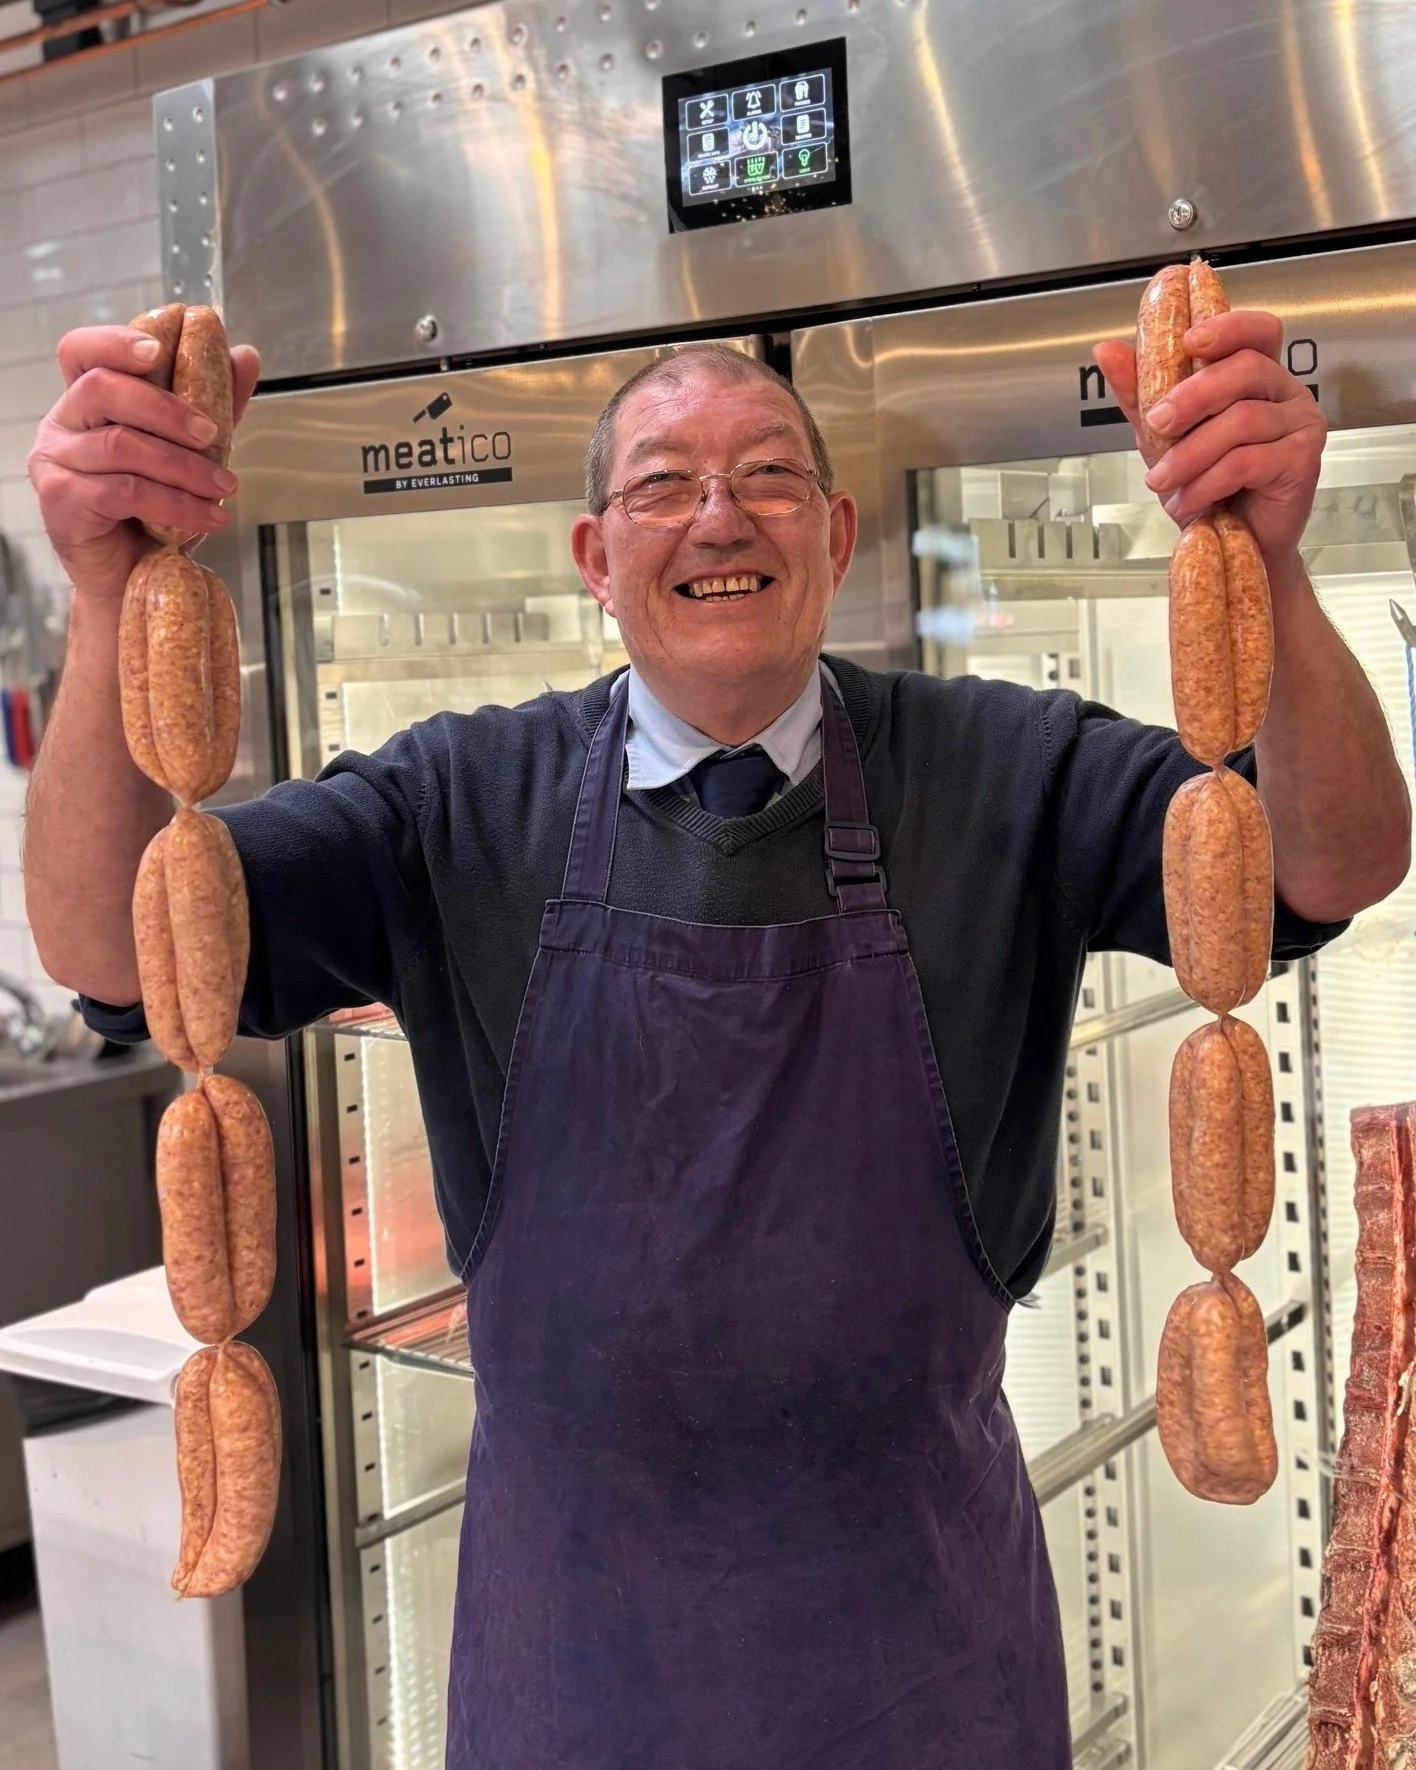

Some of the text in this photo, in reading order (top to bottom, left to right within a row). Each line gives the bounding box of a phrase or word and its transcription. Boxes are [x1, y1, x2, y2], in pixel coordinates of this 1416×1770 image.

[361, 424, 511, 473] meatico
[395, 473, 480, 490] BY EVERLASTING
